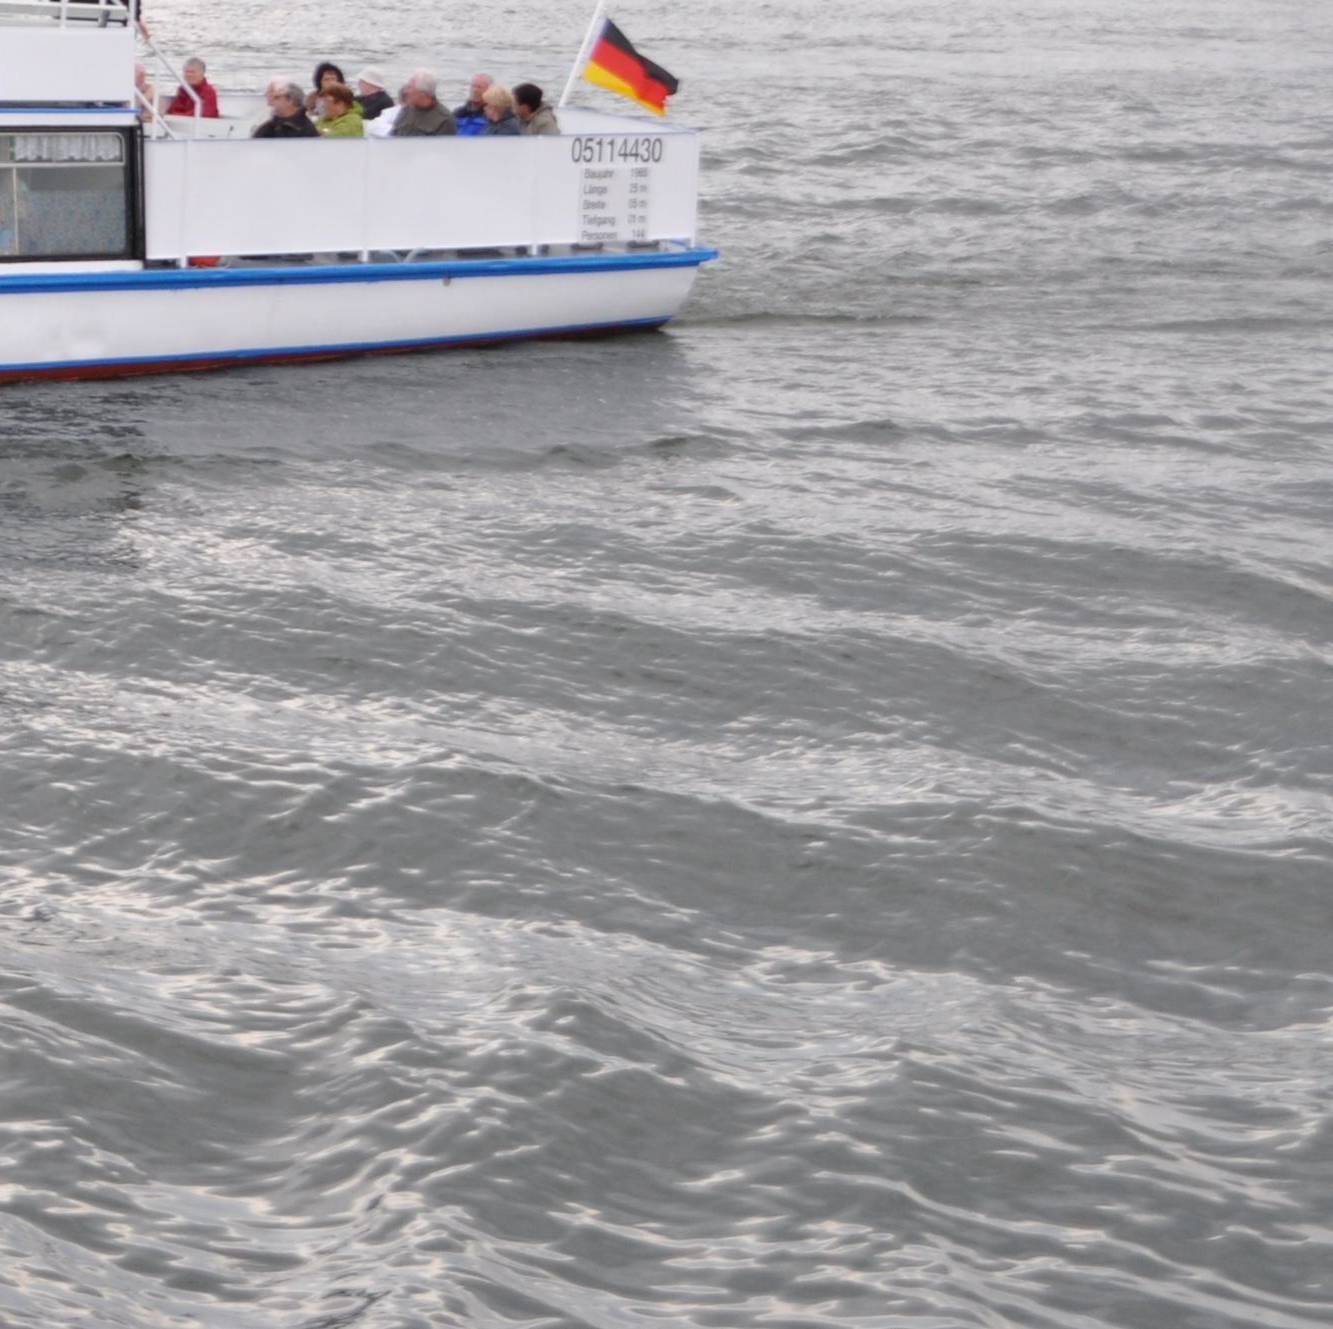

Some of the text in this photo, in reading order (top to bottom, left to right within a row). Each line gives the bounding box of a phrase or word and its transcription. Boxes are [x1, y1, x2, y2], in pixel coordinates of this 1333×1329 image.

[571, 137, 663, 163] 05114430
[583, 183, 608, 196] Länge
[583, 199, 606, 210] Breite
[582, 214, 616, 227] Tiefgang
[581, 230, 618, 241] Personen
